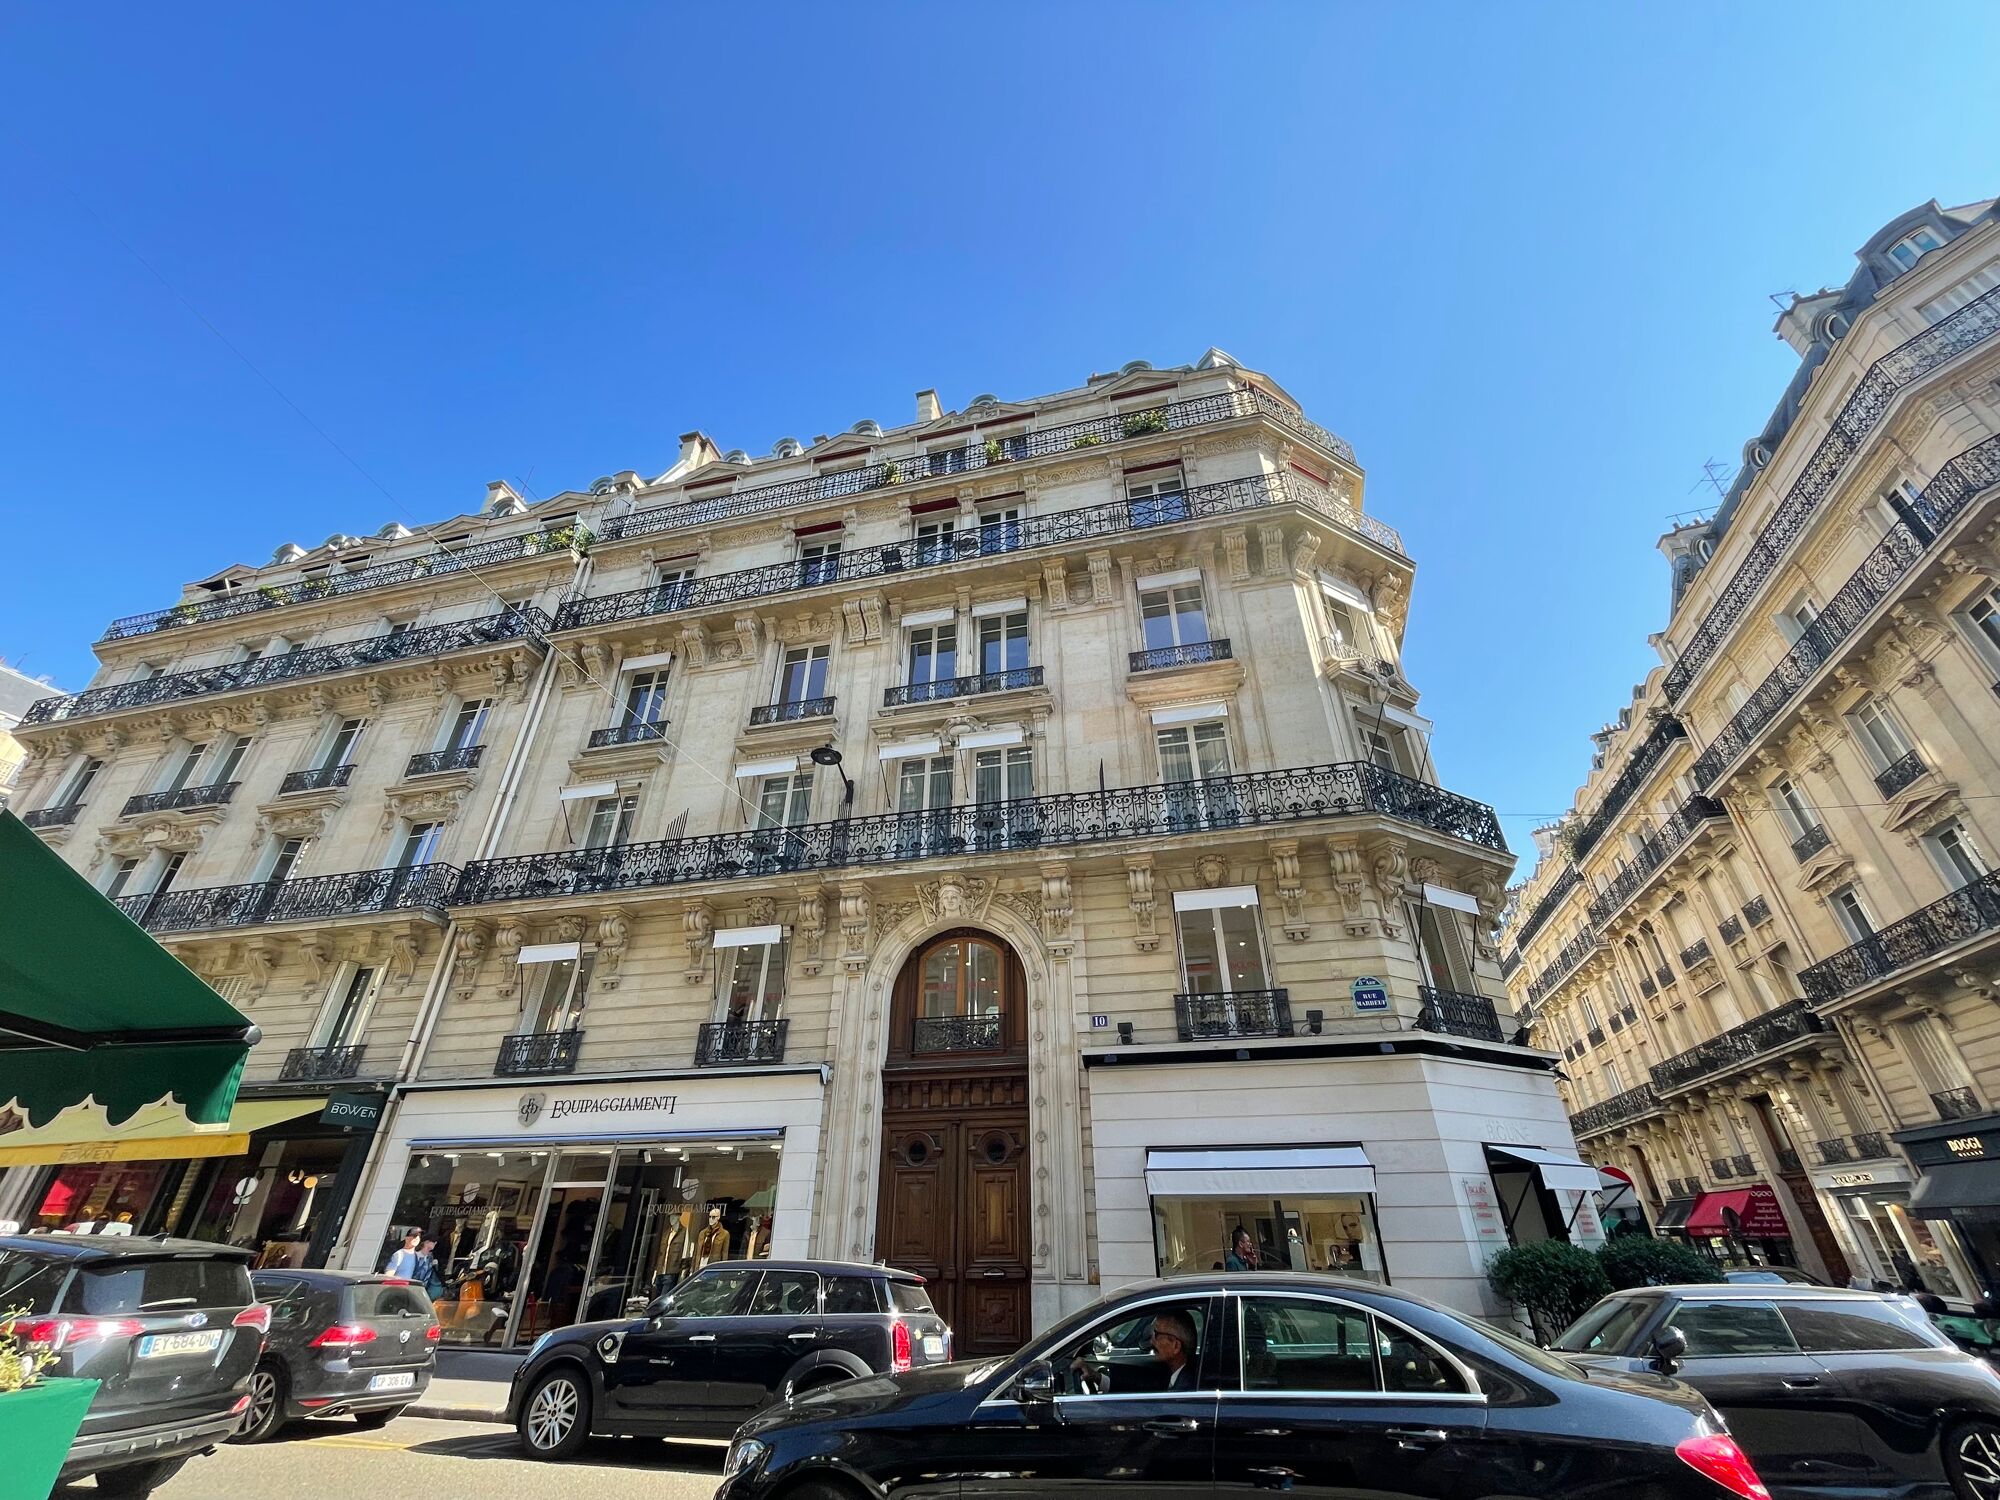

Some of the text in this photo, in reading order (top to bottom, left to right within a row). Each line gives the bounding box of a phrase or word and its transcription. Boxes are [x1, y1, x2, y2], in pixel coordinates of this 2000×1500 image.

[1094, 1016, 1106, 1027] 10
[330, 1102, 378, 1119] BOWEN
[549, 1095, 678, 1119] EQUIPAGGIAMENTI
